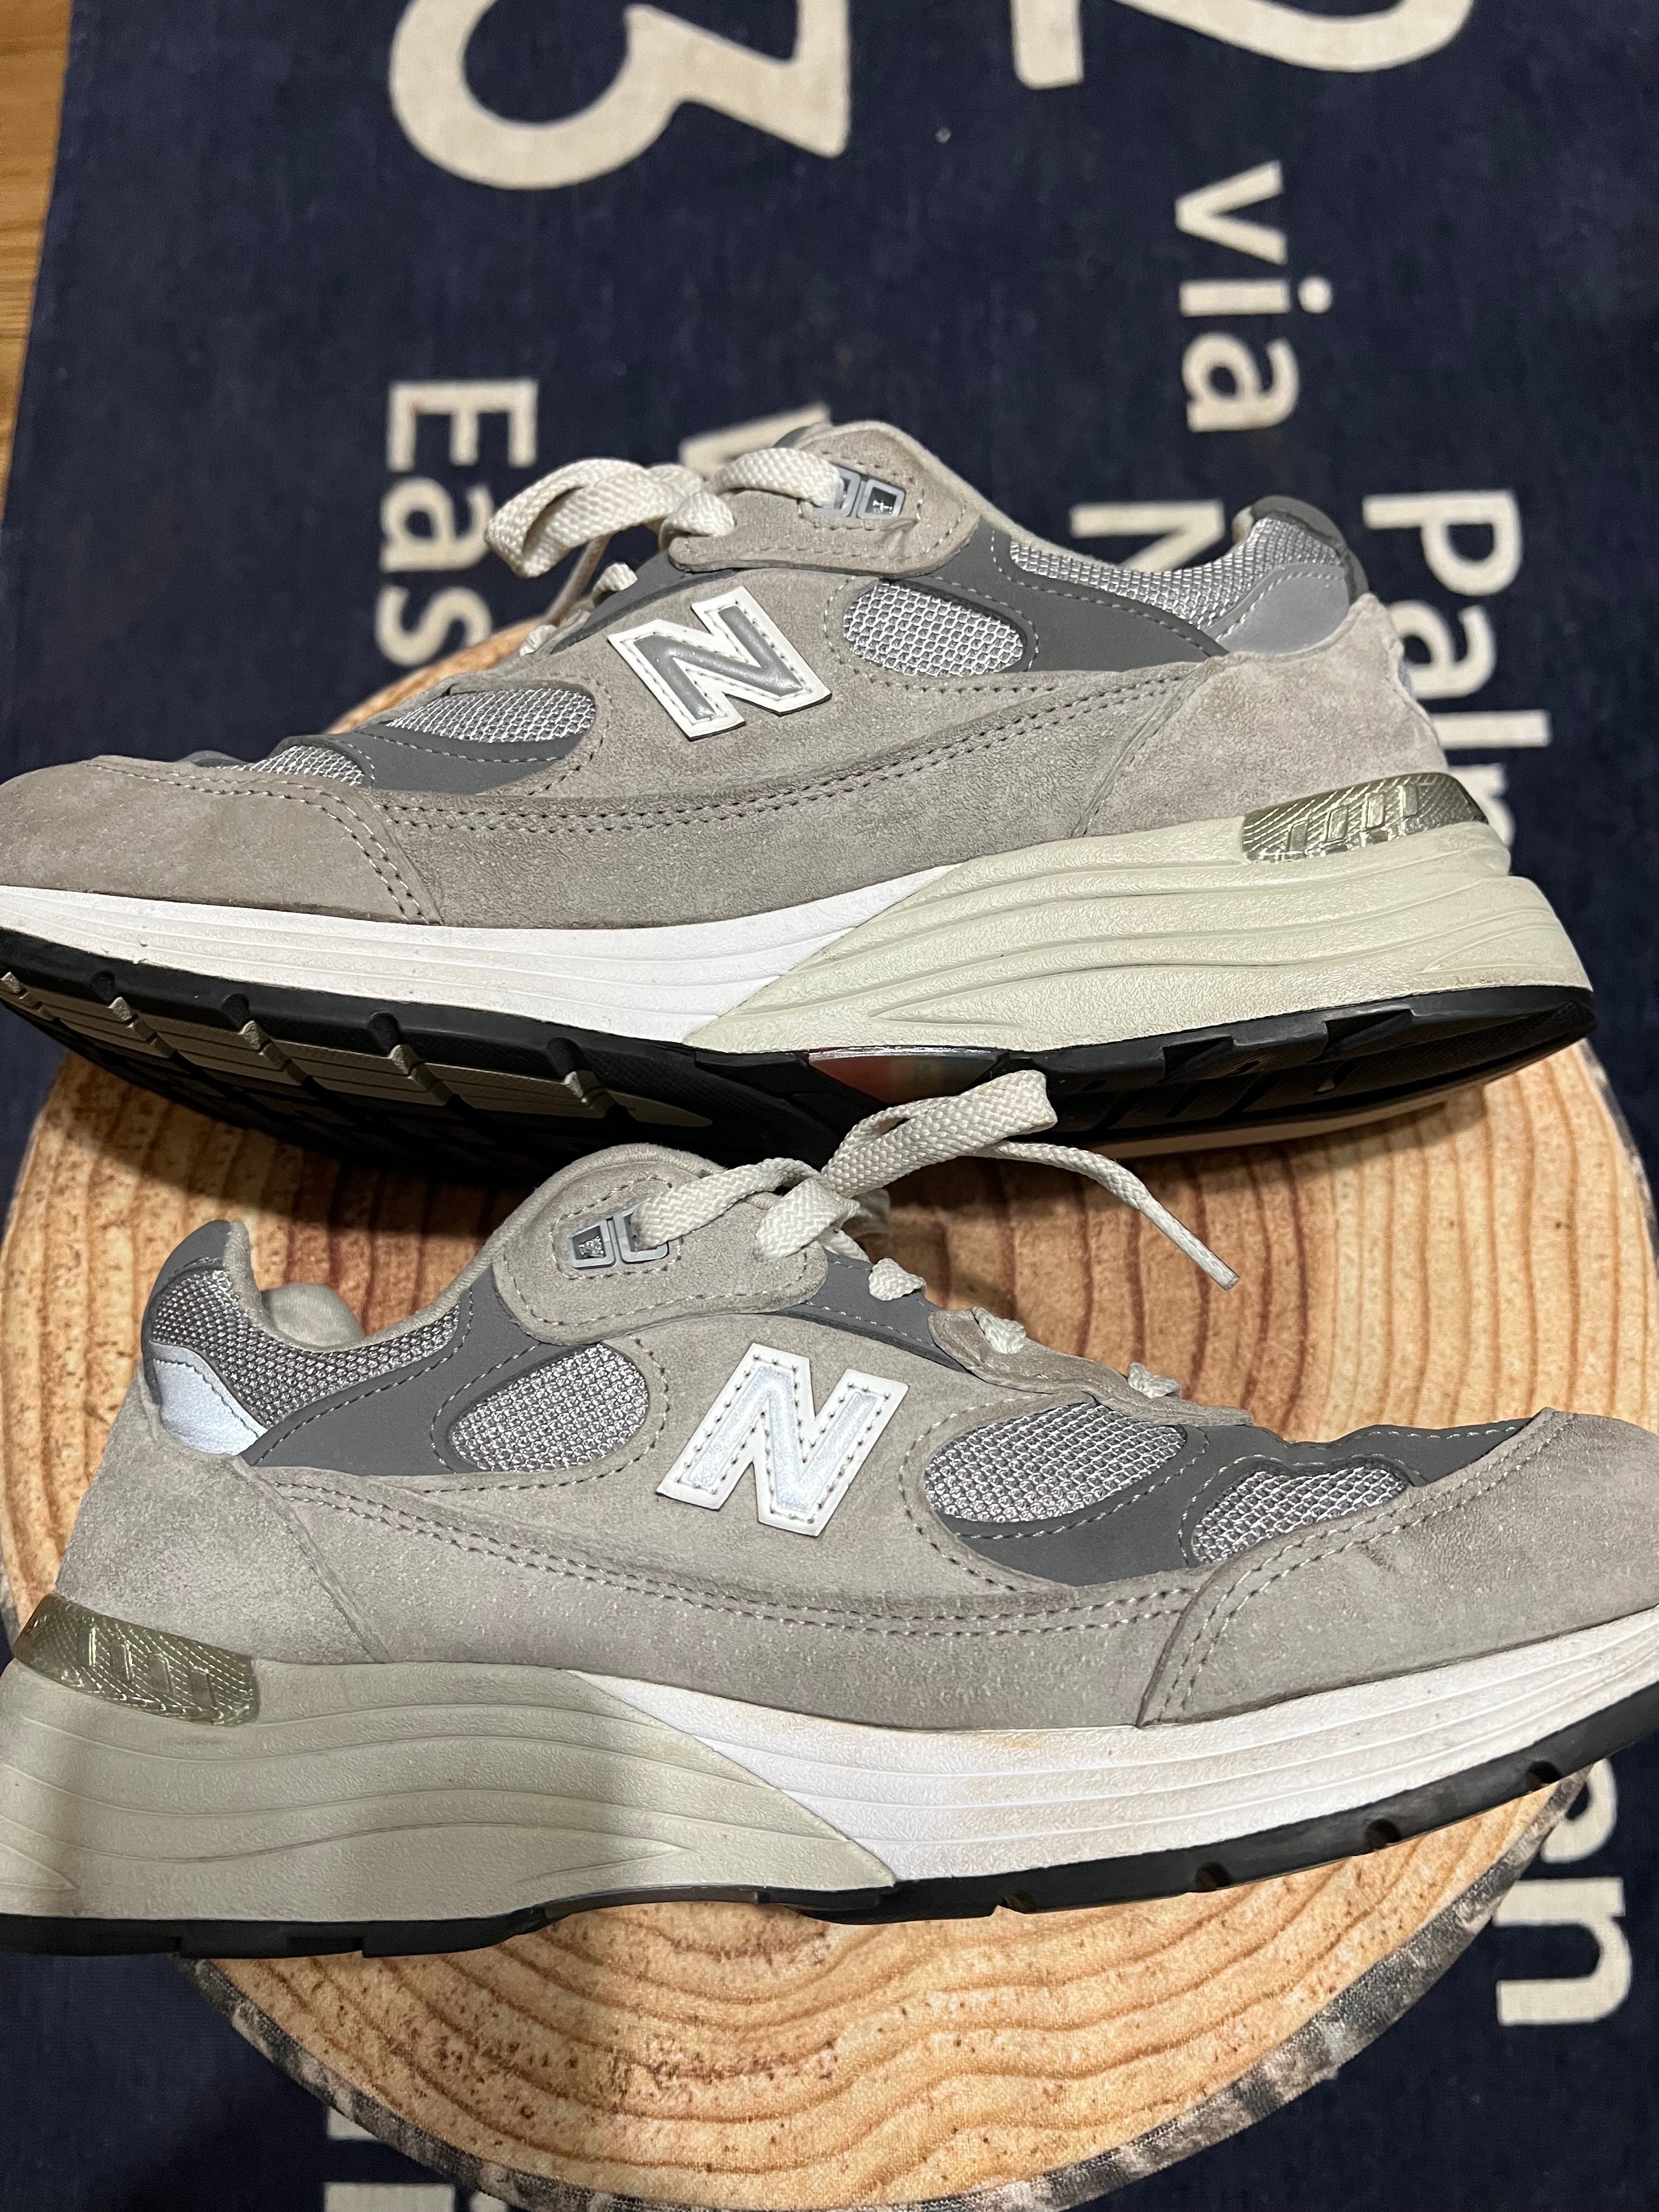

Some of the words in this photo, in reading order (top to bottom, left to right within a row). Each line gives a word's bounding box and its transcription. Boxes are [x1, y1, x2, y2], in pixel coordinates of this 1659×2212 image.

[1175, 160, 1333, 433] via
[375, 380, 538, 665] Eas
[607, 586, 832, 741] N
[656, 1342, 909, 1537] N
